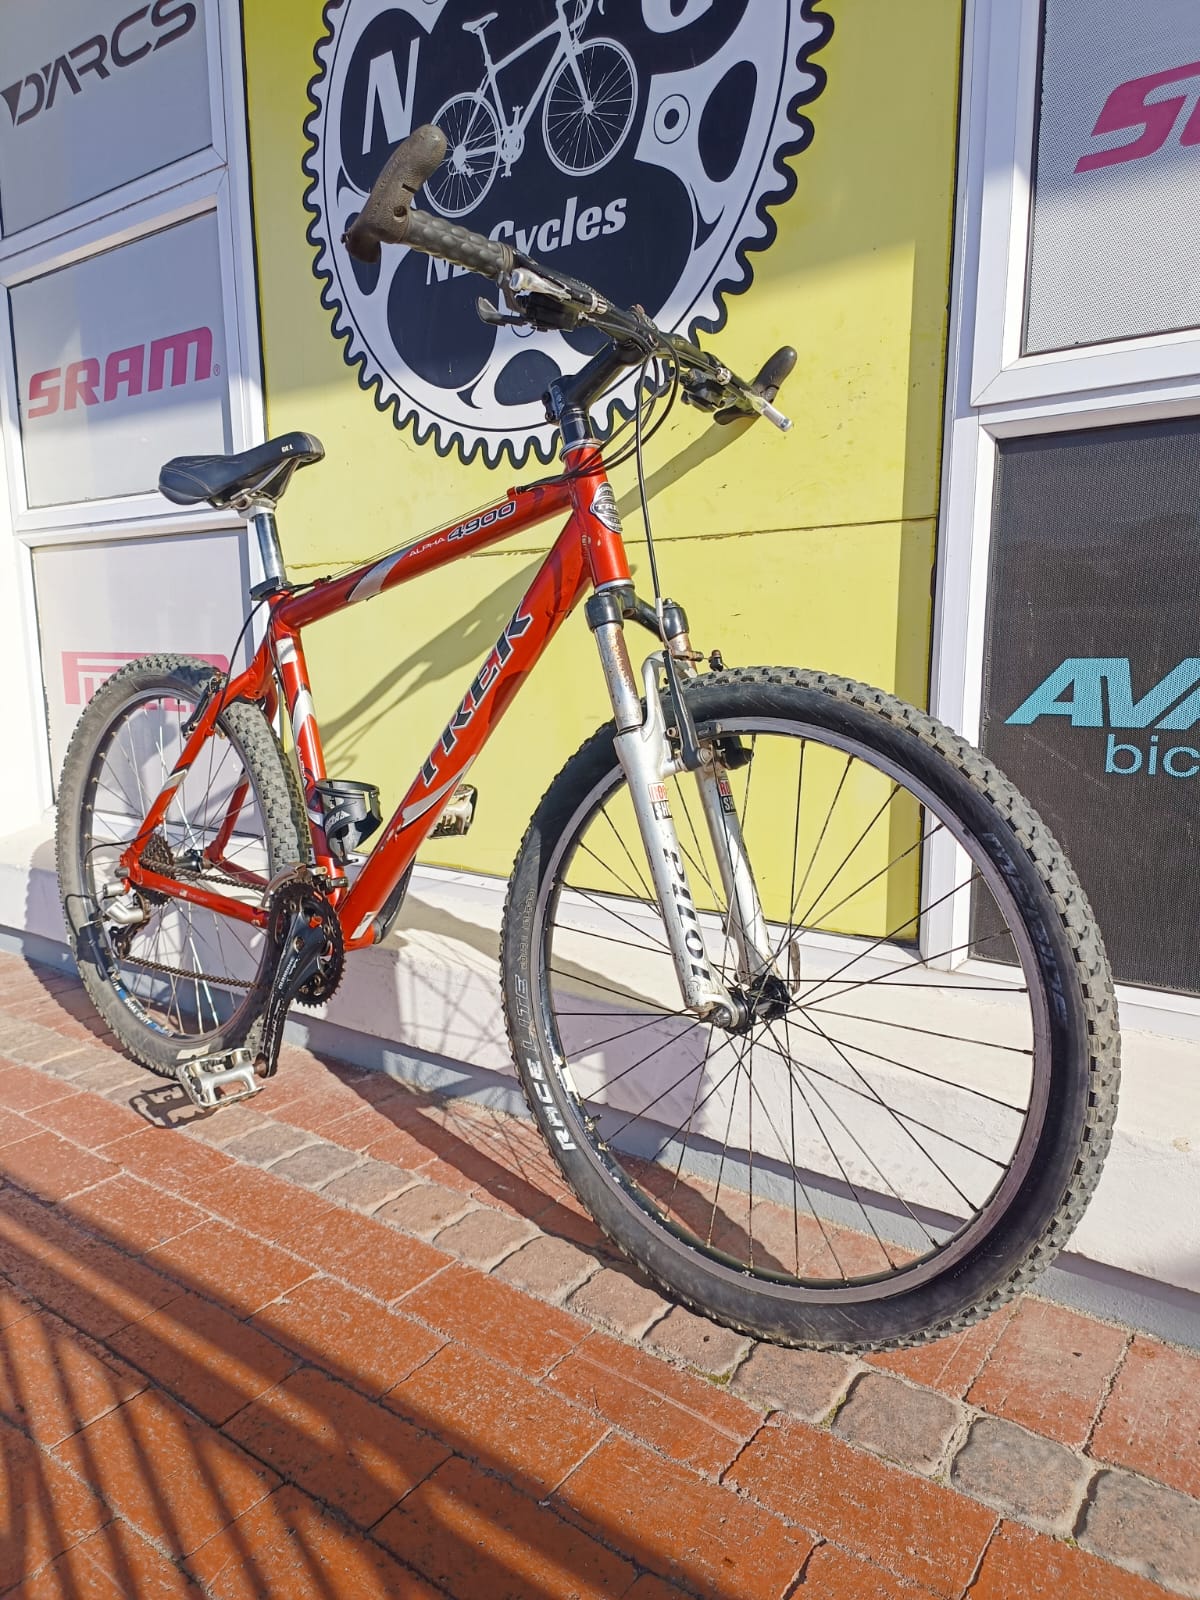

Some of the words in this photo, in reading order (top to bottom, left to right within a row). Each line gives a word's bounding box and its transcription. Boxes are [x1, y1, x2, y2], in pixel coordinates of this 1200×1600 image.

[28, 326, 213, 419] SRAM
[408, 536, 446, 557] ALPHA
[447, 500, 517, 543] 4900
[514, 974, 537, 1052] LITE
[525, 1057, 577, 1151] RACE
